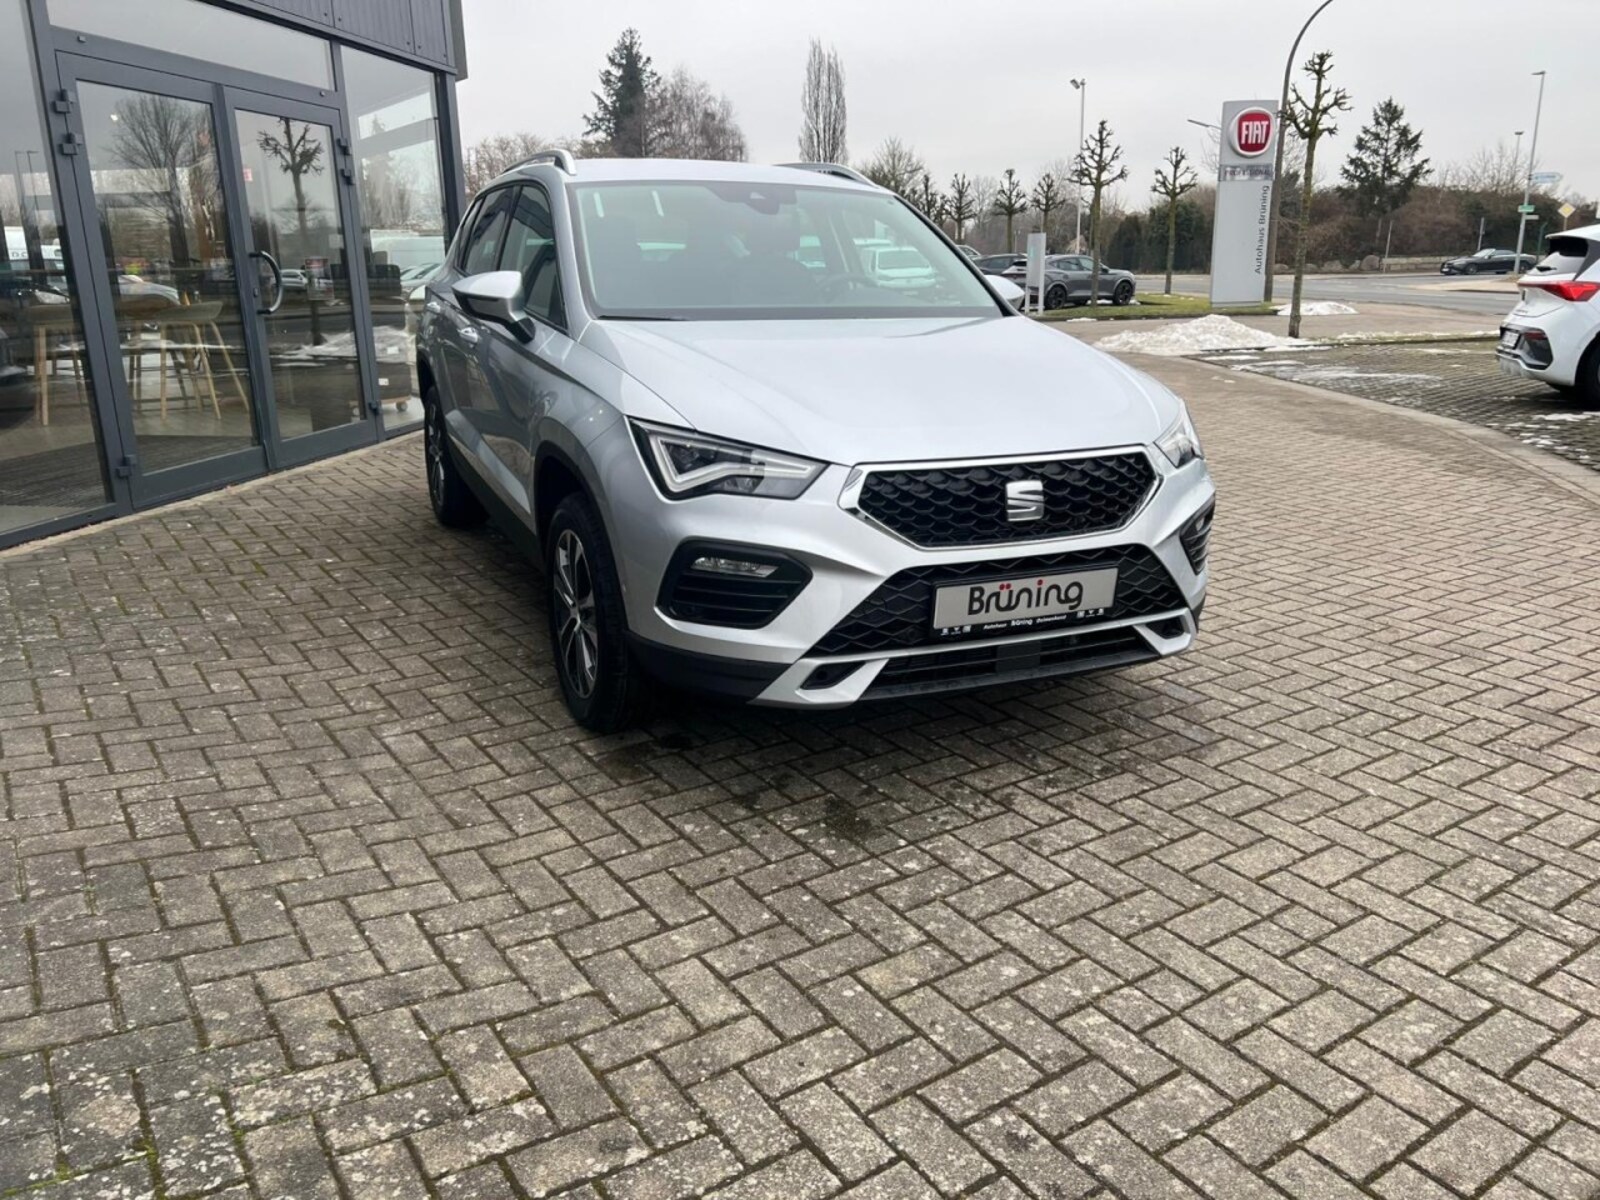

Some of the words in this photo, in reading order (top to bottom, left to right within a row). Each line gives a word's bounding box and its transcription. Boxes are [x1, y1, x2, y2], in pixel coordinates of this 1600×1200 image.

[1241, 120, 1269, 144] FIAT
[1254, 226, 1265, 275] Autohaus
[967, 579, 1084, 616] Brüning
